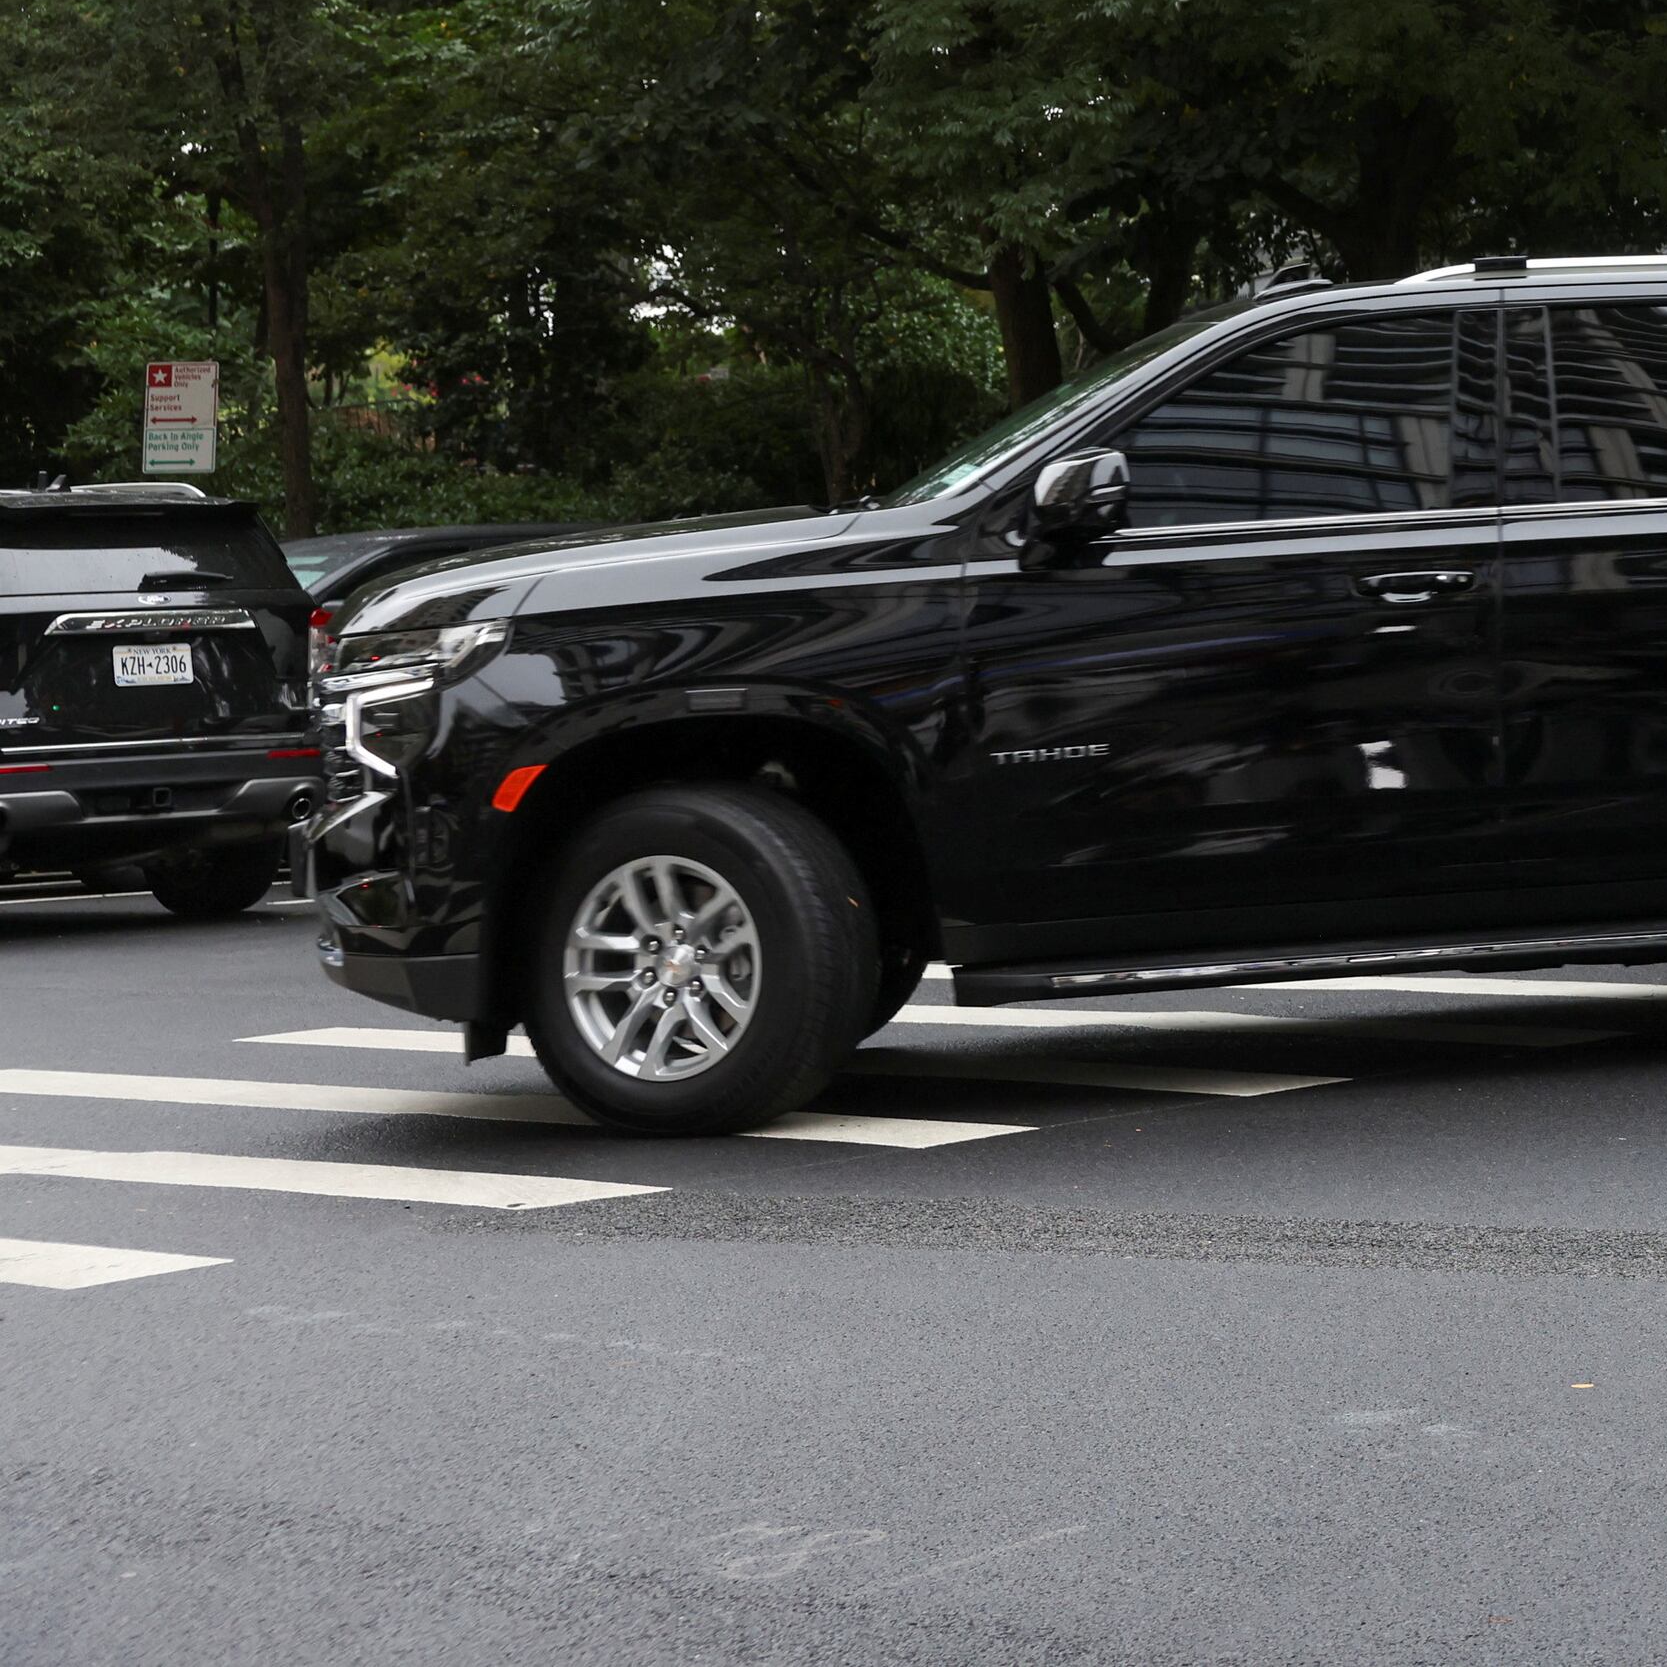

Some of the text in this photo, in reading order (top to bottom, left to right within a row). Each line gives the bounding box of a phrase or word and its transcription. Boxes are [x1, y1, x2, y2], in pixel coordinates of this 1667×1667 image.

[150, 394, 180, 402] Support
[150, 404, 182, 412] Services
[148, 432, 204, 442] Back In Angle
[148, 442, 200, 452] Parking Only
[133, 646, 172, 655] NEW YORK
[120, 654, 187, 676] KZH 2306
[989, 743, 1111, 765] TAHOE
